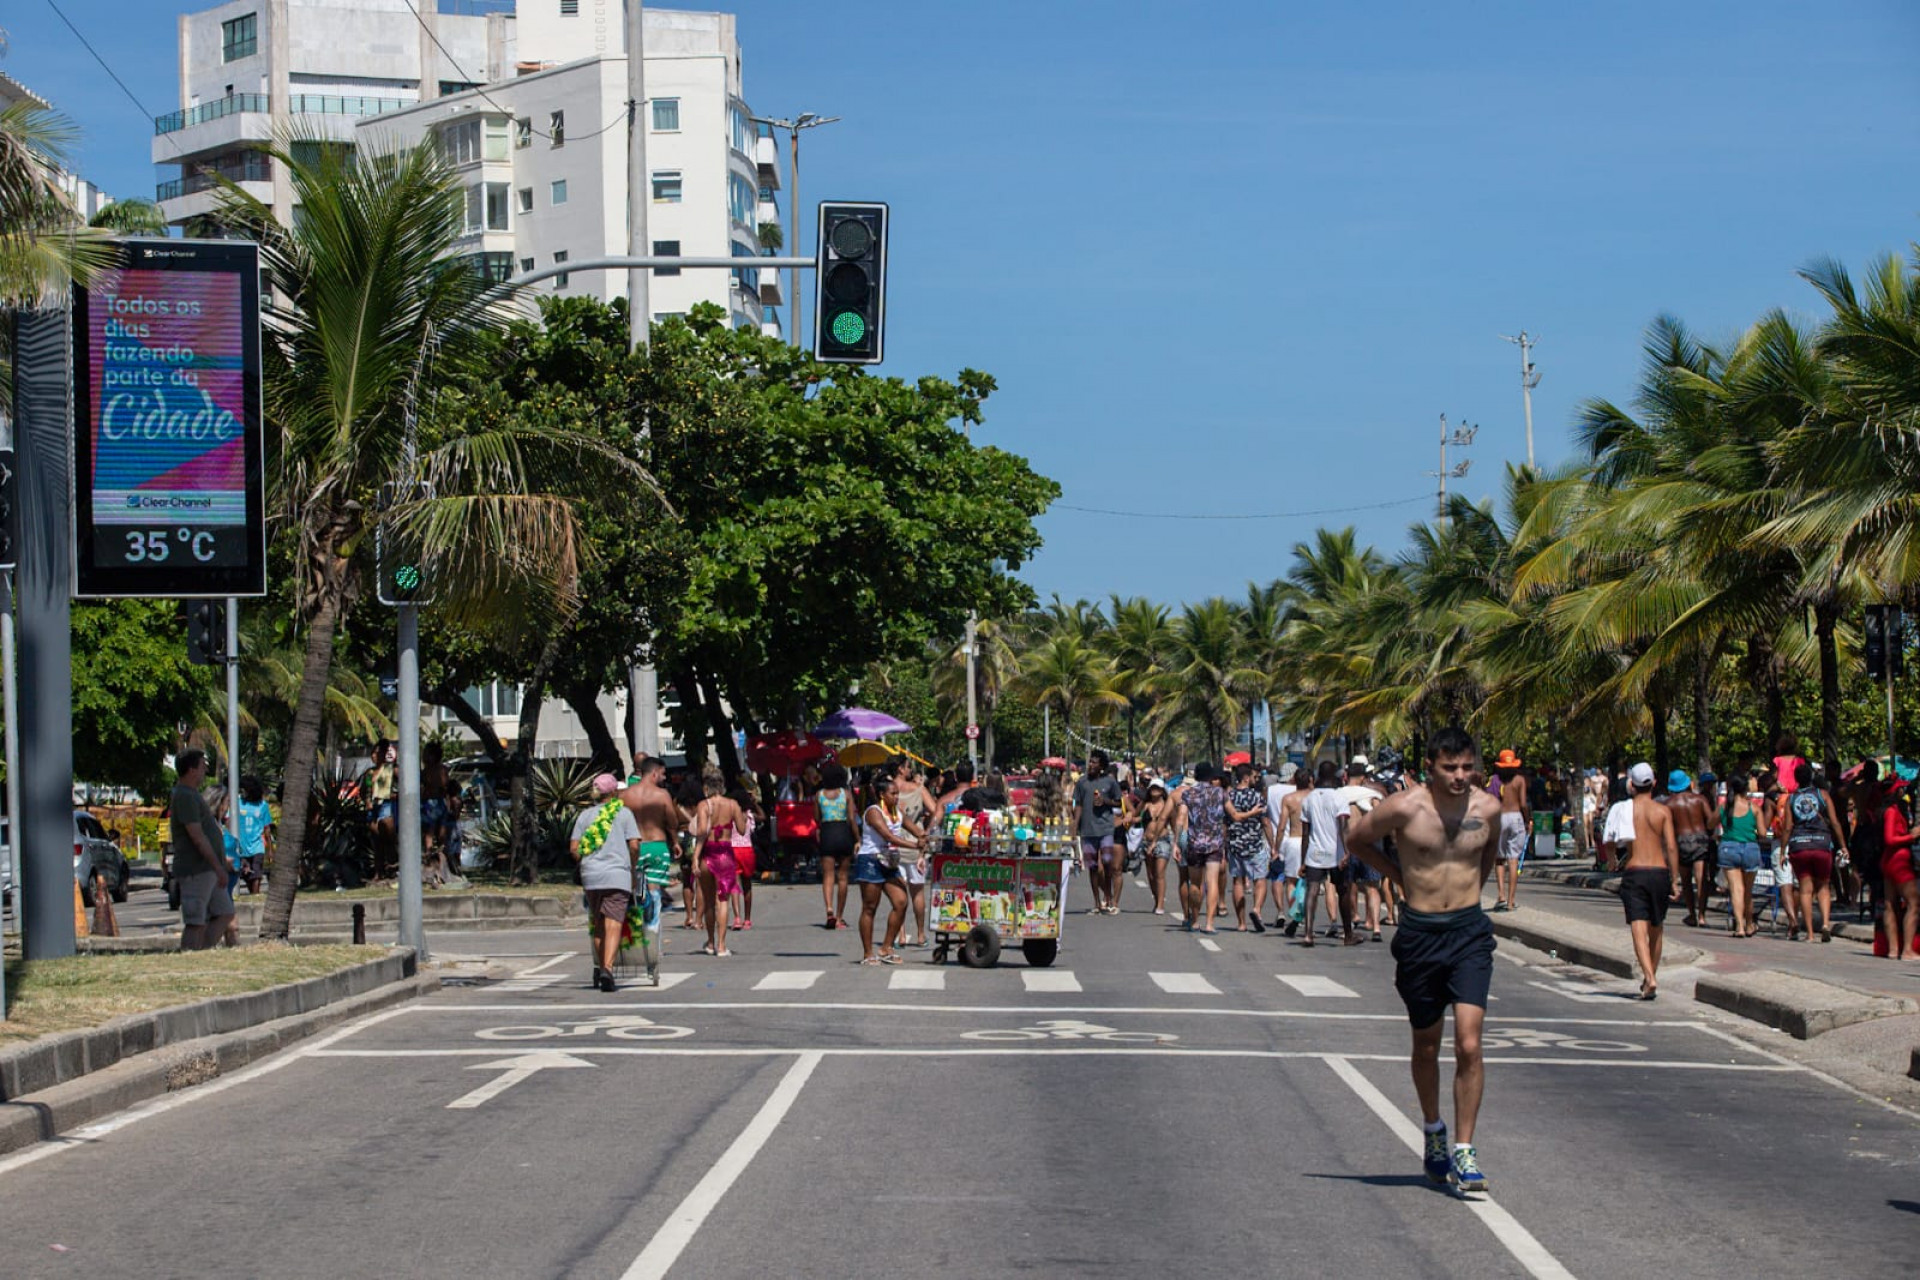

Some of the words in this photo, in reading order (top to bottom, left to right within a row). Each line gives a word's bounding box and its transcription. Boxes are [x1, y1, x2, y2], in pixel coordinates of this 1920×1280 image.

[104, 293, 169, 314] Todos
[176, 300, 200, 315] os
[104, 318, 151, 338] dias
[104, 341, 194, 361] fazendo
[104, 367, 164, 390] parte
[170, 367, 199, 386] da
[102, 388, 234, 440] Cidade
[124, 530, 170, 562] 35
